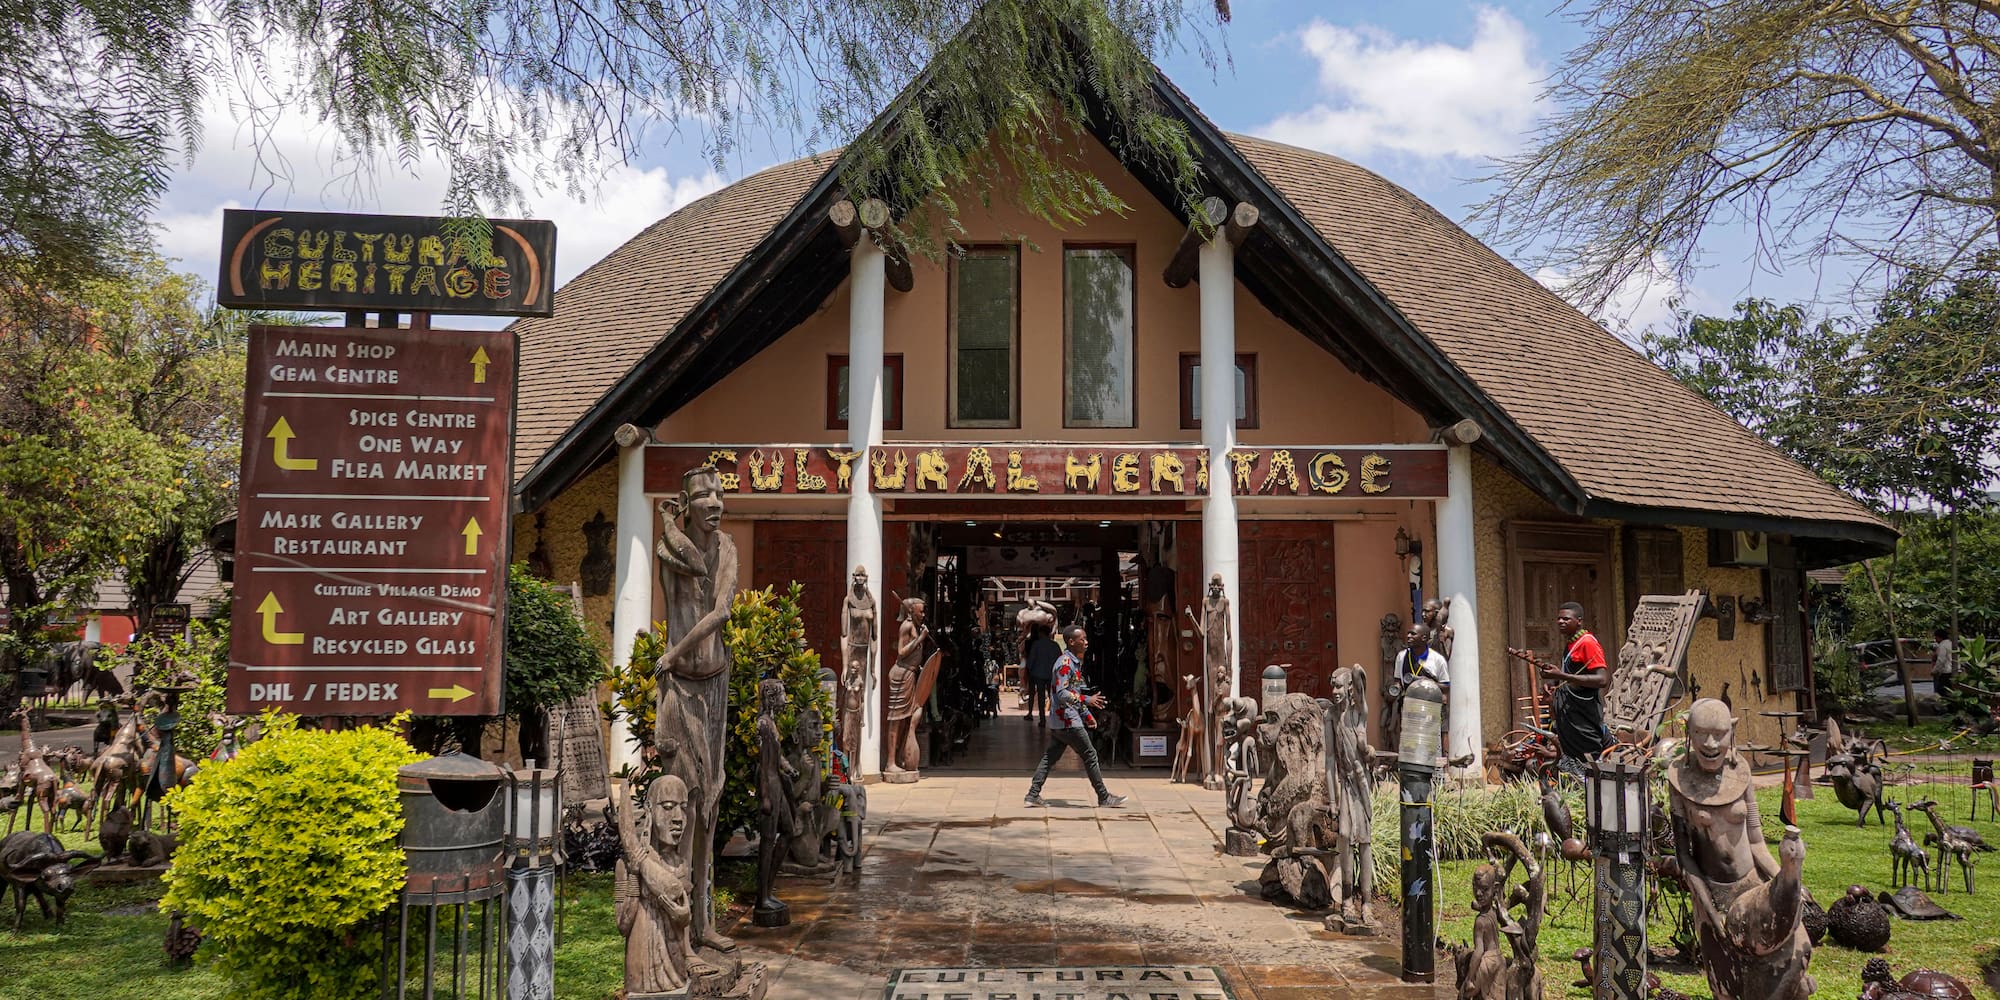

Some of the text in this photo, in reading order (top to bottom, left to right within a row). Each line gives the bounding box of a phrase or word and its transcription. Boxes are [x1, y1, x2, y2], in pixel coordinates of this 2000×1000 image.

[260, 258, 511, 299] HERITAGE
[275, 339, 396, 360] MAIN SHOP
[270, 364, 399, 385] GEM CENTRE
[349, 409, 476, 429] SPICE CENTRE
[359, 435, 463, 455] ONE WAY
[330, 459, 487, 482] FLEA MARKET
[701, 448, 1393, 494] CULTURAL HERITAGE
[259, 511, 424, 530] MASK GALLERY
[274, 536, 408, 556] RESTAURANT
[314, 583, 372, 597] CULTURE
[440, 584, 482, 598] DEMO
[329, 607, 464, 627] ART GALLERY
[312, 636, 476, 655] RECYCLED GLASS
[250, 682, 399, 702] DHL / FEDEX
[902, 970, 1215, 983] CULTURAL
